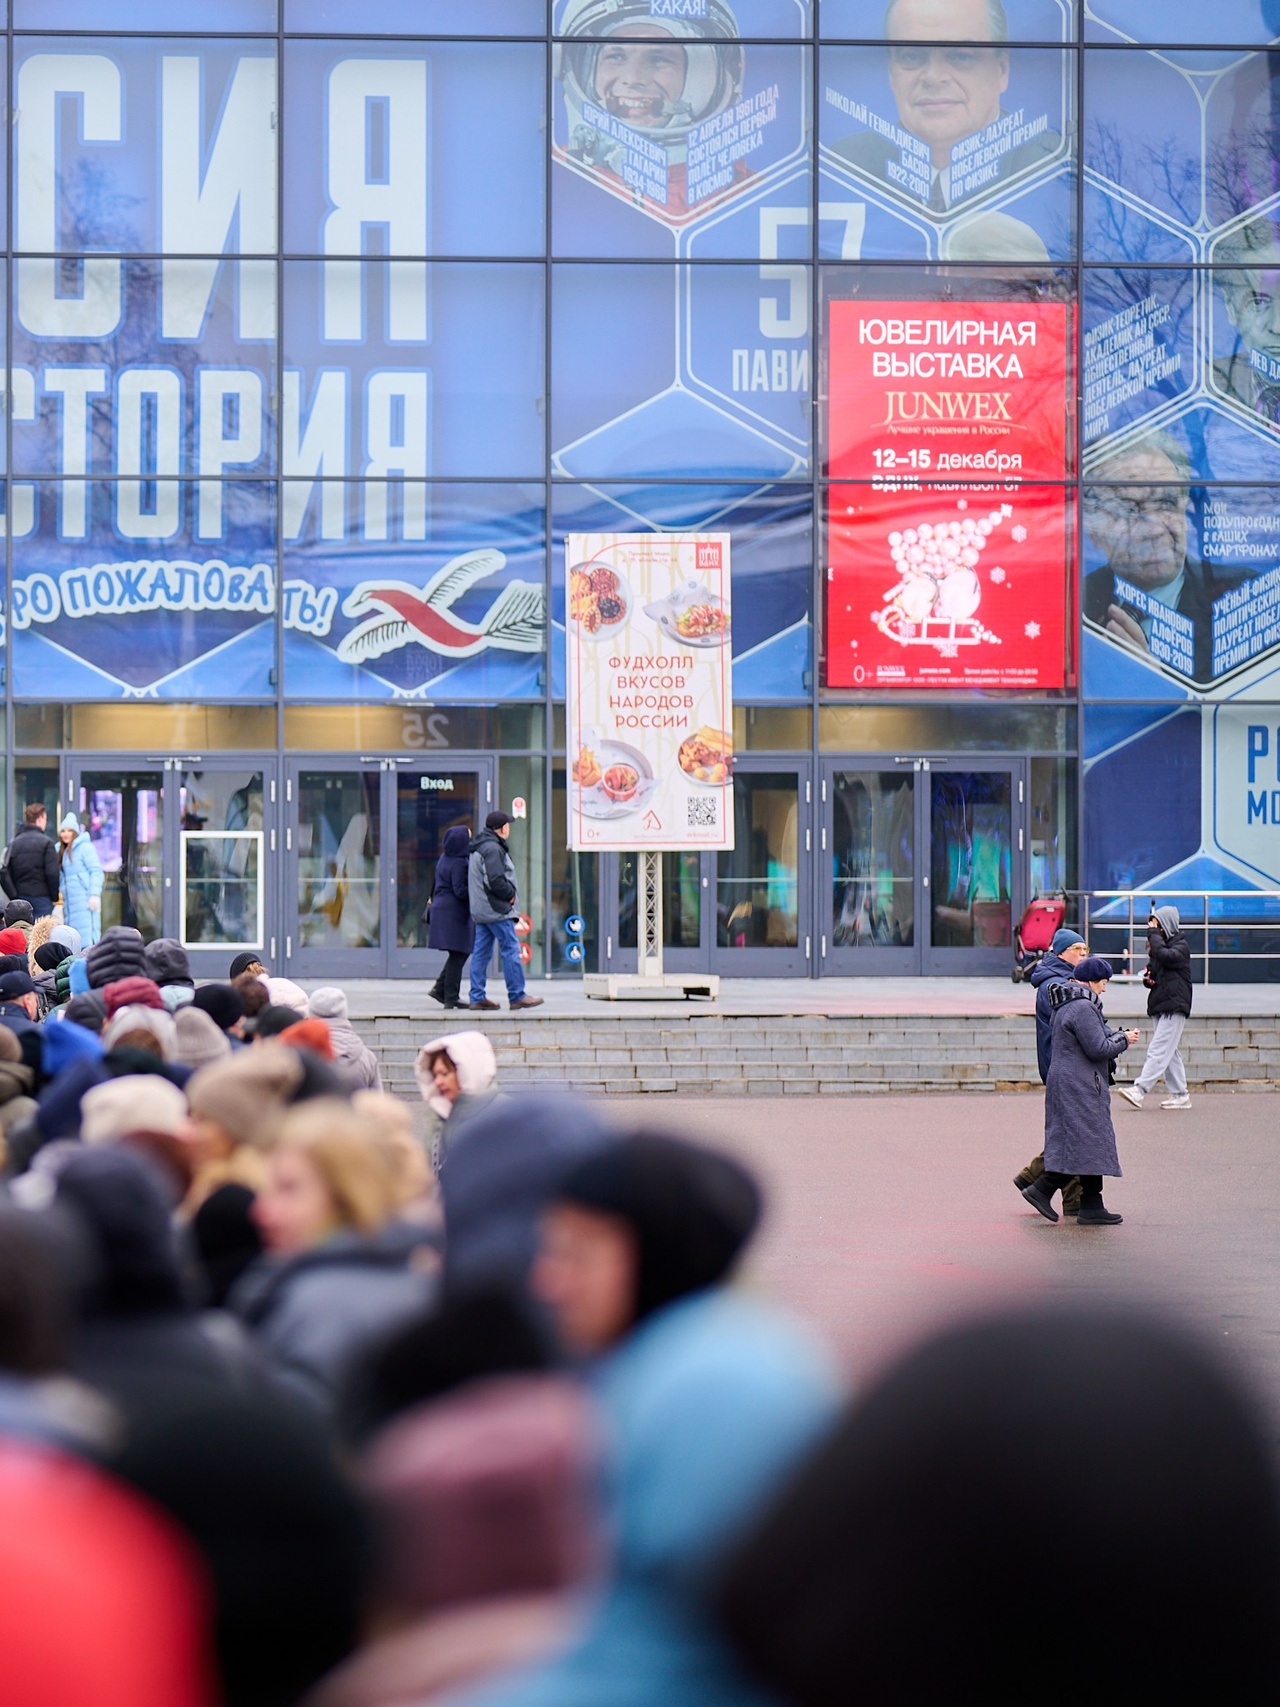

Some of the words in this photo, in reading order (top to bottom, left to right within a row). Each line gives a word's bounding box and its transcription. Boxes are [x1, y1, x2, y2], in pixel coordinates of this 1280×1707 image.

[651, 0, 706, 15] КАКАЯ!
[583, 102, 610, 132] ЮРИЙ
[611, 119, 666, 166] АЛЕКСЕЕВИЧ
[688, 131, 698, 148] 12
[699, 111, 734, 143] АПРЕЛЯ
[755, 84, 779, 111] ГОДА
[826, 86, 867, 125] НИКОЛАЙ
[868, 111, 930, 162] ГЕННАДИЕВИЧ
[688, 125, 739, 167] СОСТОЯЛСЯ
[740, 103, 776, 137] ПЕРВЫЙ
[719, 130, 763, 169] ЧЕЛОВЕКА
[951, 133, 1011, 182] НОБЕЛЕВСКОЙ
[1013, 113, 1047, 147] ПРЕМИИ
[628, 149, 666, 186] ГАГАРИН
[887, 160, 929, 199] 1922-2001
[901, 149, 930, 181] БАСОВ
[951, 180, 963, 200] ПО
[965, 159, 999, 191] ФИЗИКЕ
[688, 188, 694, 205] В
[696, 166, 733, 201] КОСМОС
[859, 319, 1036, 346] ЮВЕЛИРНАЯ
[1085, 326, 1132, 367] АКАДЕМИК
[732, 349, 808, 392] ПАВИ
[873, 352, 1024, 379] ВЫСТАВКА
[1085, 331, 1154, 385] ОБЩЕСТВЕННЫЙ
[1128, 343, 1166, 378] ЛАУРЕАТ
[1250, 349, 1267, 372] ЛЕВ
[1085, 371, 1144, 422] НОБЕЛЕВСКОЙ
[1146, 353, 1180, 387] ПРЕМИИ
[884, 391, 1012, 424] JUNWEX
[980, 425, 1010, 435] России
[1085, 414, 1109, 441] МИРА
[937, 449, 1022, 473] декабря
[1203, 543, 1278, 557] СМАРТФОНАХ
[1116, 577, 1146, 610] ЖОРЕС
[1148, 597, 1193, 638] ИВАНОВИЧ
[1151, 636, 1193, 675] 1930-2019
[1152, 619, 1193, 656] АЛФЁРОВ
[1214, 619, 1253, 656] ЛАУРЕАТ
[1214, 640, 1249, 675] ПРЕМИИ
[1251, 633, 1262, 654] ПО
[608, 656, 693, 672] ФУДХОЛЛ
[617, 676, 685, 688] ВКУСОВ
[609, 695, 694, 711] НАРОДОВ
[615, 715, 688, 728] РОССИИ
[420, 776, 454, 791] Вход
